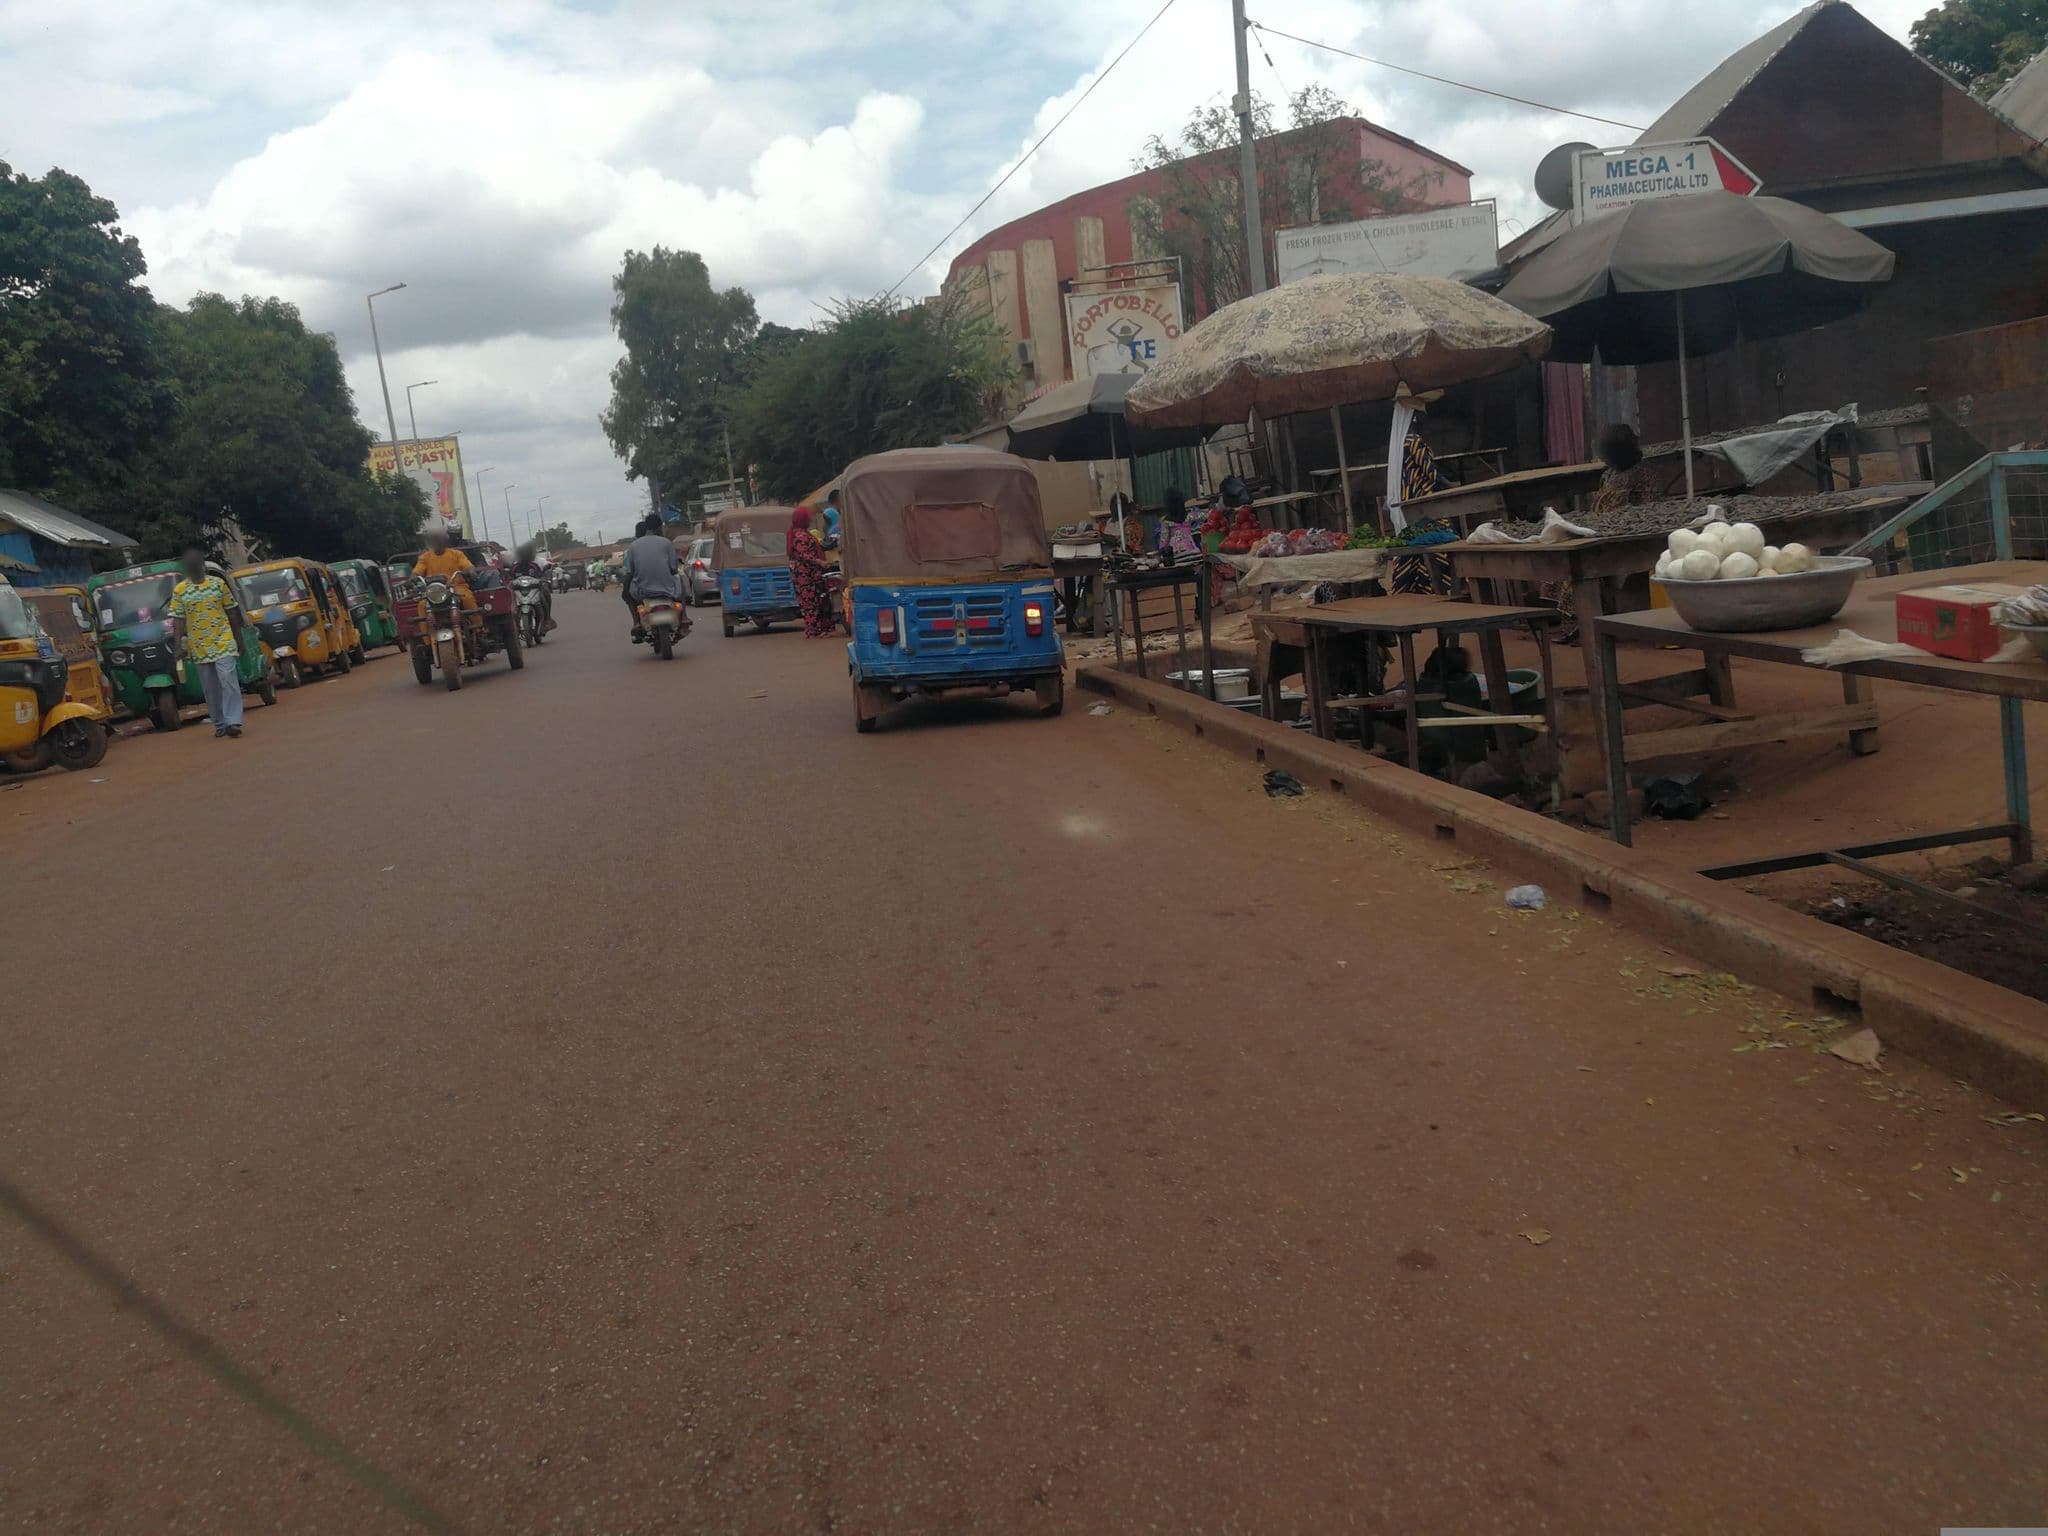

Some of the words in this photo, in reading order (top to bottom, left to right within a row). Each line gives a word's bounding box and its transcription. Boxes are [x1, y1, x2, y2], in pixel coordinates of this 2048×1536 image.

[1606, 156, 1670, 179] MEGA
[1589, 177, 1687, 200] PHARMACEUTICAL
[1689, 174, 1709, 188] LTD
[1286, 238, 1310, 250] FRESH
[1312, 233, 1342, 247] FROZEN
[1344, 230, 1361, 241] FISH
[1373, 222, 1405, 239] CHICKEN
[1073, 295, 1180, 348] PORTOBELLO
[405, 441, 445, 453] NOODLES
[377, 457, 398, 472] HO
